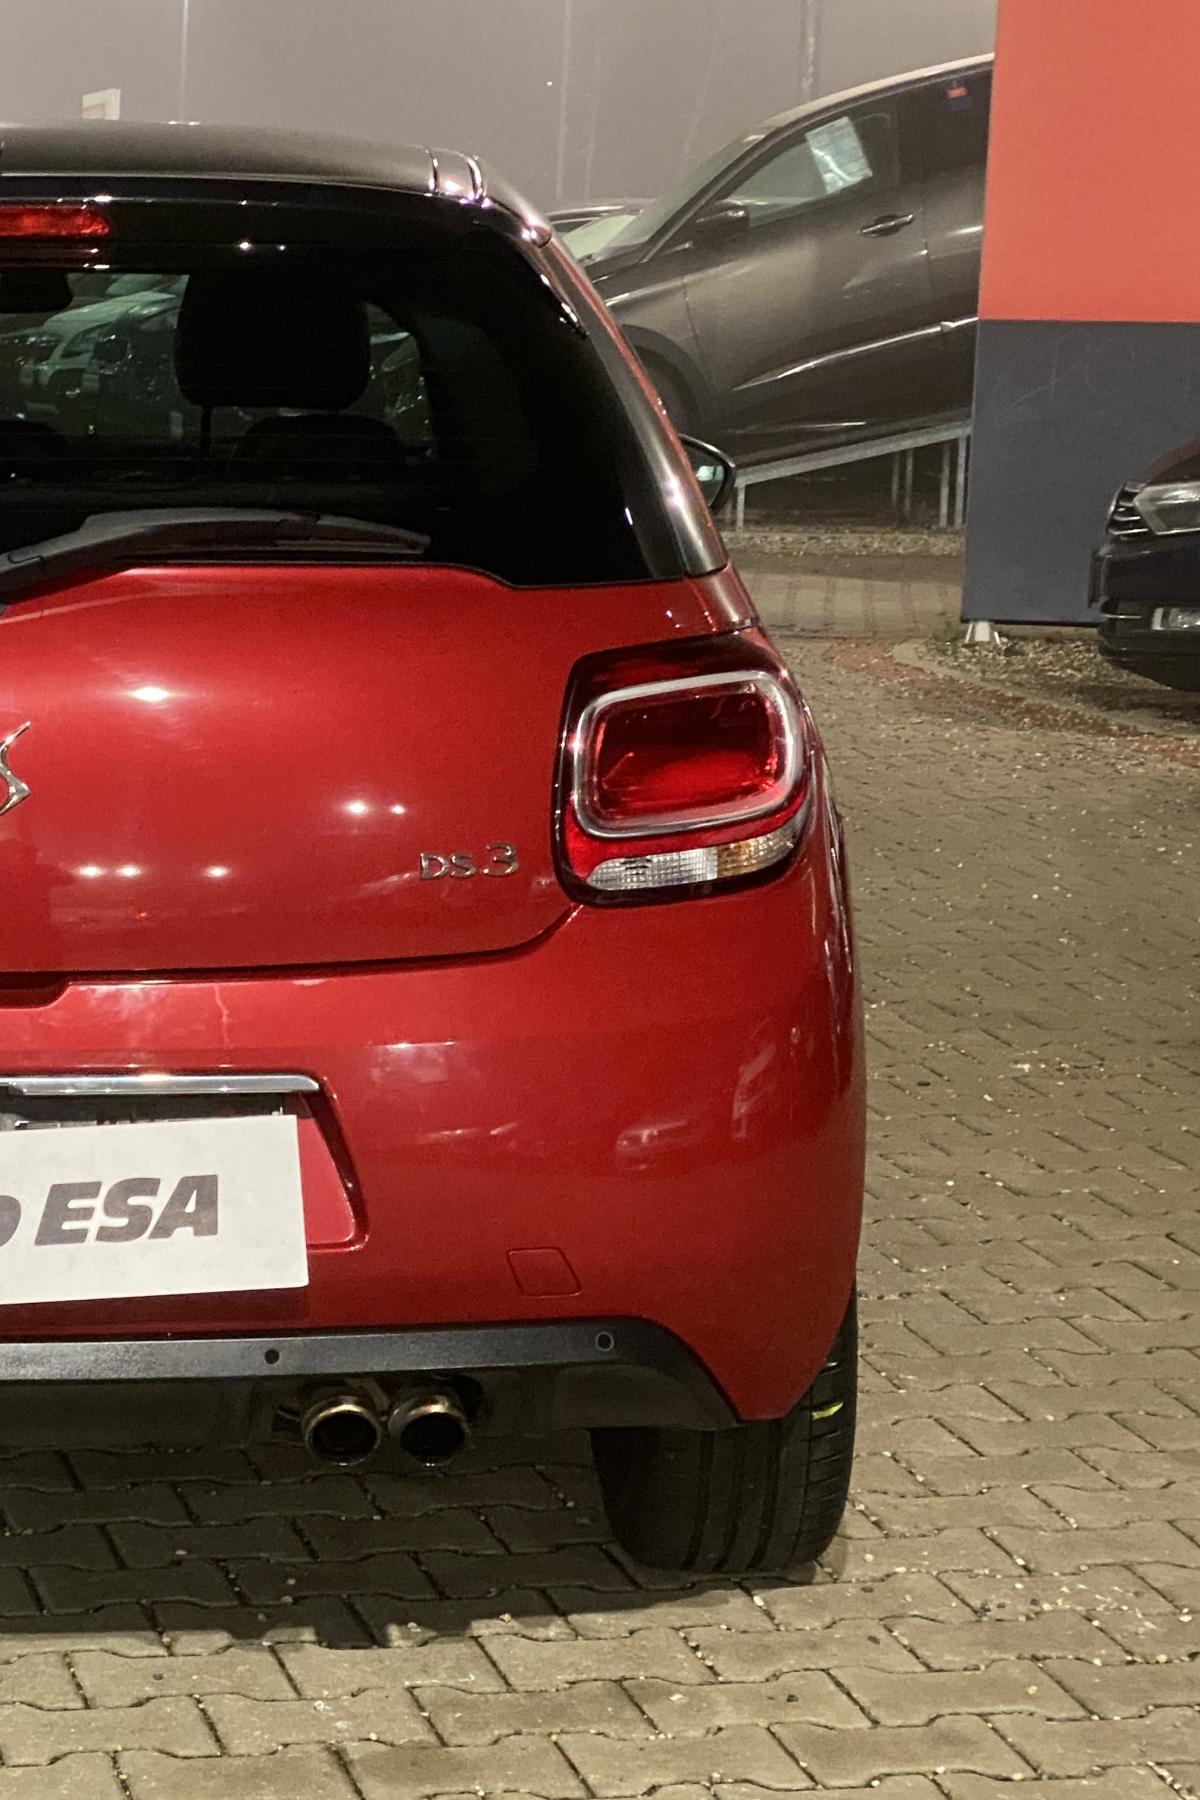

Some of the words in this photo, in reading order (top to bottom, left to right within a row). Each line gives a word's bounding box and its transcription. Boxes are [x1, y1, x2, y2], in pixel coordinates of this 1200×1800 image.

[420, 851, 477, 879] DS
[482, 842, 518, 877] 3
[33, 1173, 219, 1247] ESA
